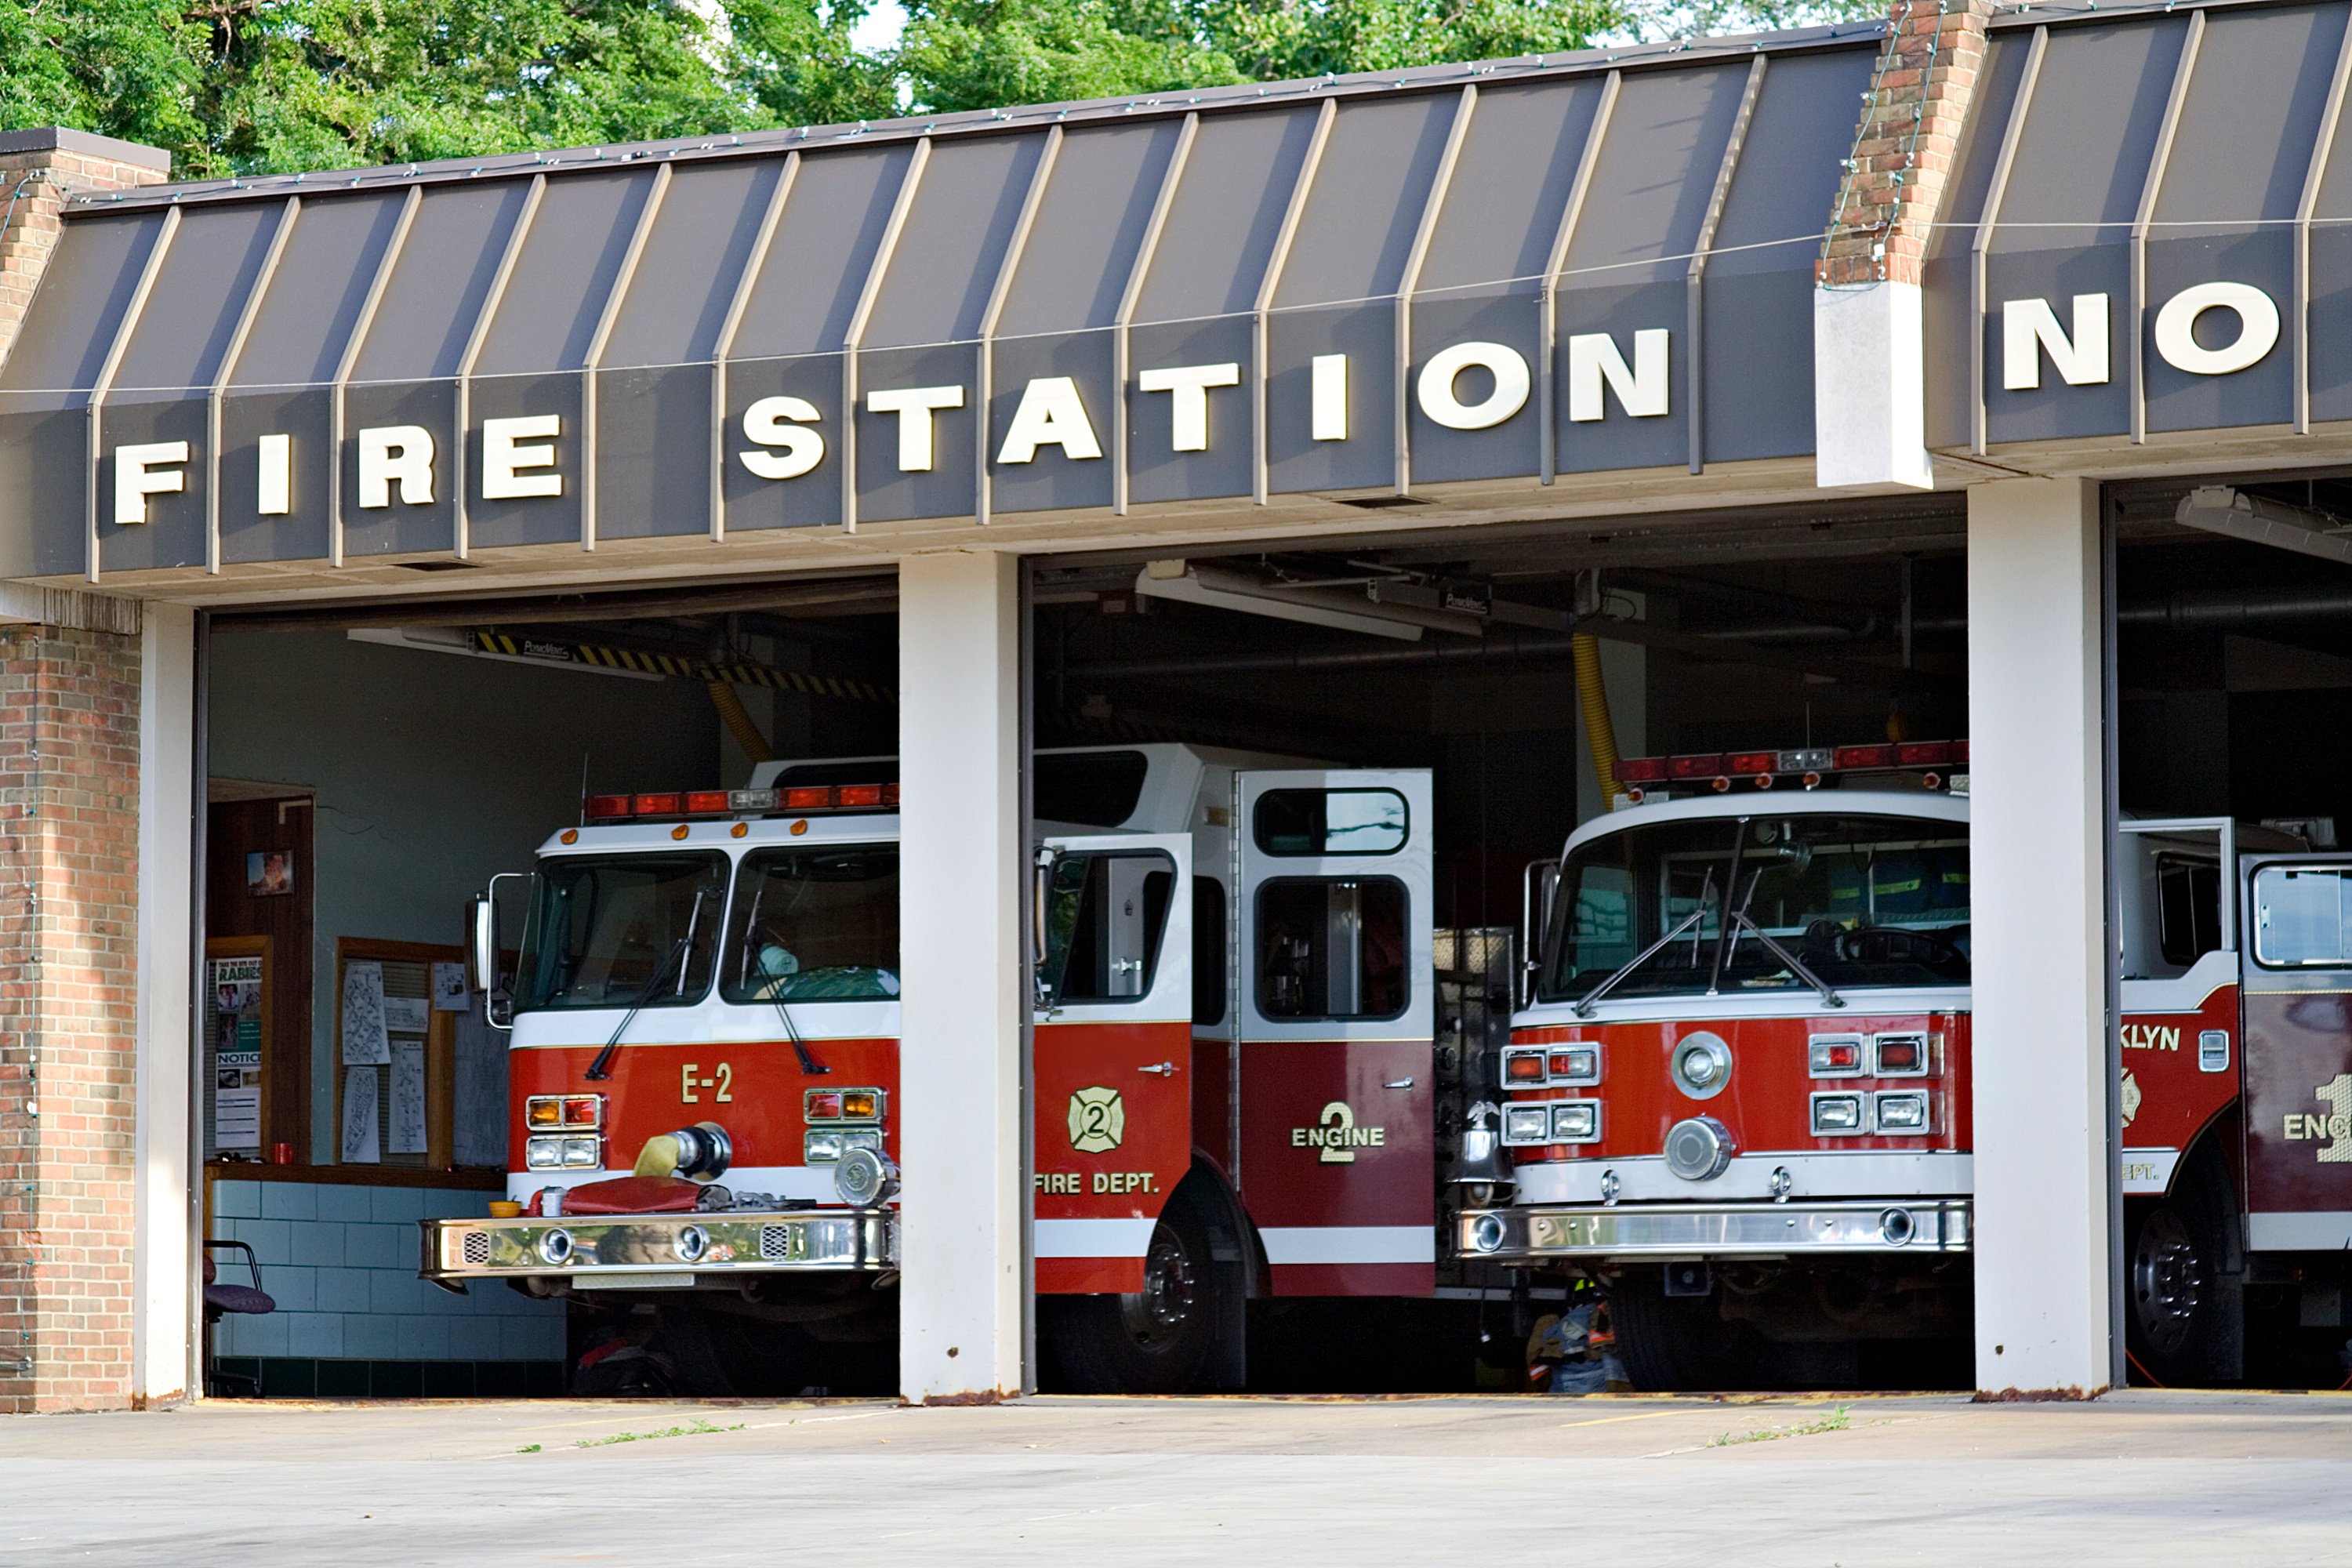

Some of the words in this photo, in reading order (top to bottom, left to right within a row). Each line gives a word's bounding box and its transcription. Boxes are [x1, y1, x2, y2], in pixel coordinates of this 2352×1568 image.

[114, 415, 562, 524] FIRE
[740, 328, 1670, 479] STATION
[2003, 281, 2281, 390] NO
[219, 967, 262, 981] RABIES
[681, 1062, 732, 1103] E-2
[1087, 1105, 1105, 1134] 2
[1320, 1102, 1355, 1163] 2
[1291, 1127, 1385, 1147] ENGINE
[1033, 1173, 1082, 1194] FIRE
[1093, 1173, 1160, 1194] DEPT.
